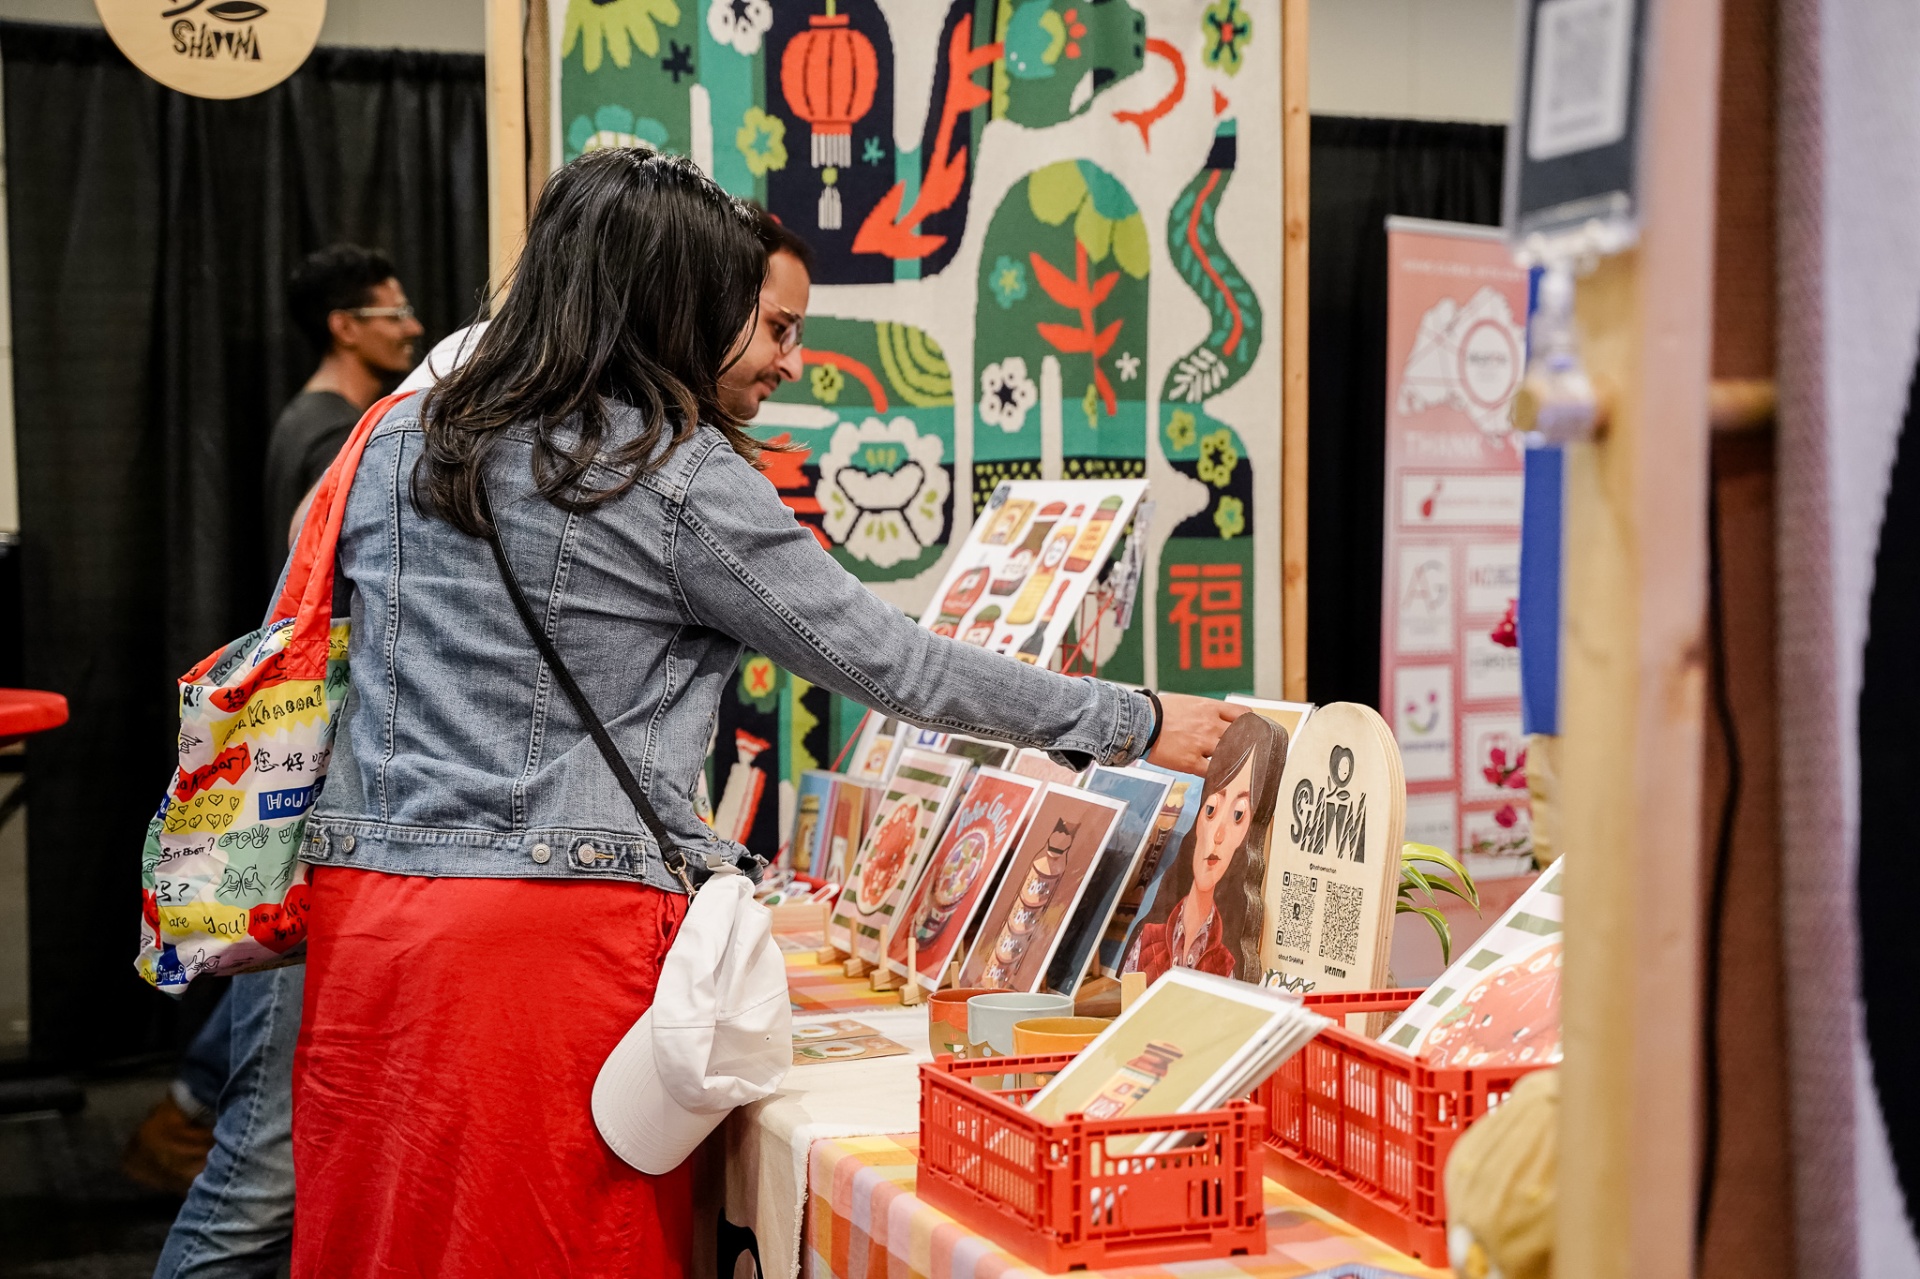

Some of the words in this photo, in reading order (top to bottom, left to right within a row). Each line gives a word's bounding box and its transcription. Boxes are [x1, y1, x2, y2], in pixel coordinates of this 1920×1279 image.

[1168, 563, 1243, 671] 福
[169, 917, 190, 928] are
[1324, 964, 1347, 979] venmo
